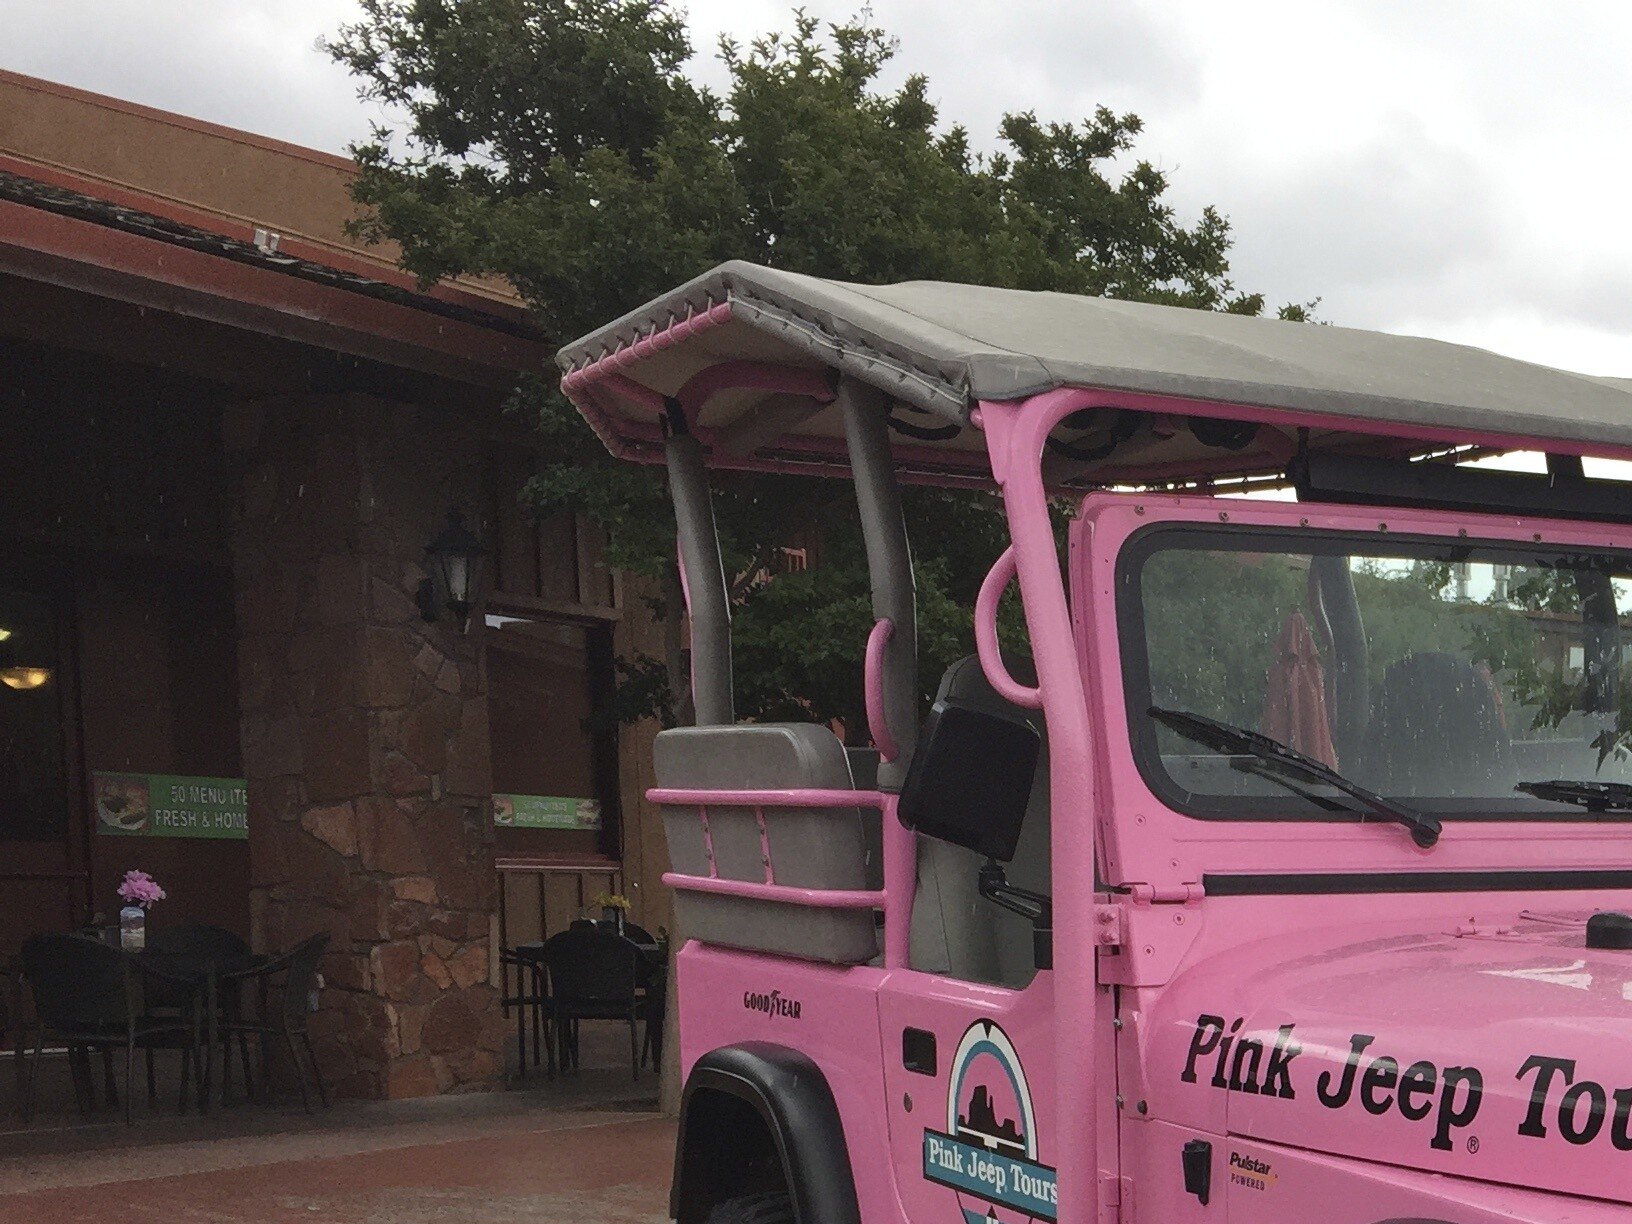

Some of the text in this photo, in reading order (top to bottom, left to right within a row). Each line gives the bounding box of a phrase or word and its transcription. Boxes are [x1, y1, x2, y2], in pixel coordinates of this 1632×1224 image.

[171, 786, 186, 803] 50
[190, 786, 226, 805] MENU
[155, 809, 197, 828] FRESH
[201, 811, 211, 828] &
[743, 990, 801, 1019] GOODYEAR
[1181, 1013, 1304, 1099] Pink
[1317, 1033, 1484, 1152] Jeep
[929, 1137, 1058, 1206] Pink Jeep Tours
[1229, 1151, 1272, 1176] Pulstar
[1230, 1173, 1266, 1191] POWERED
